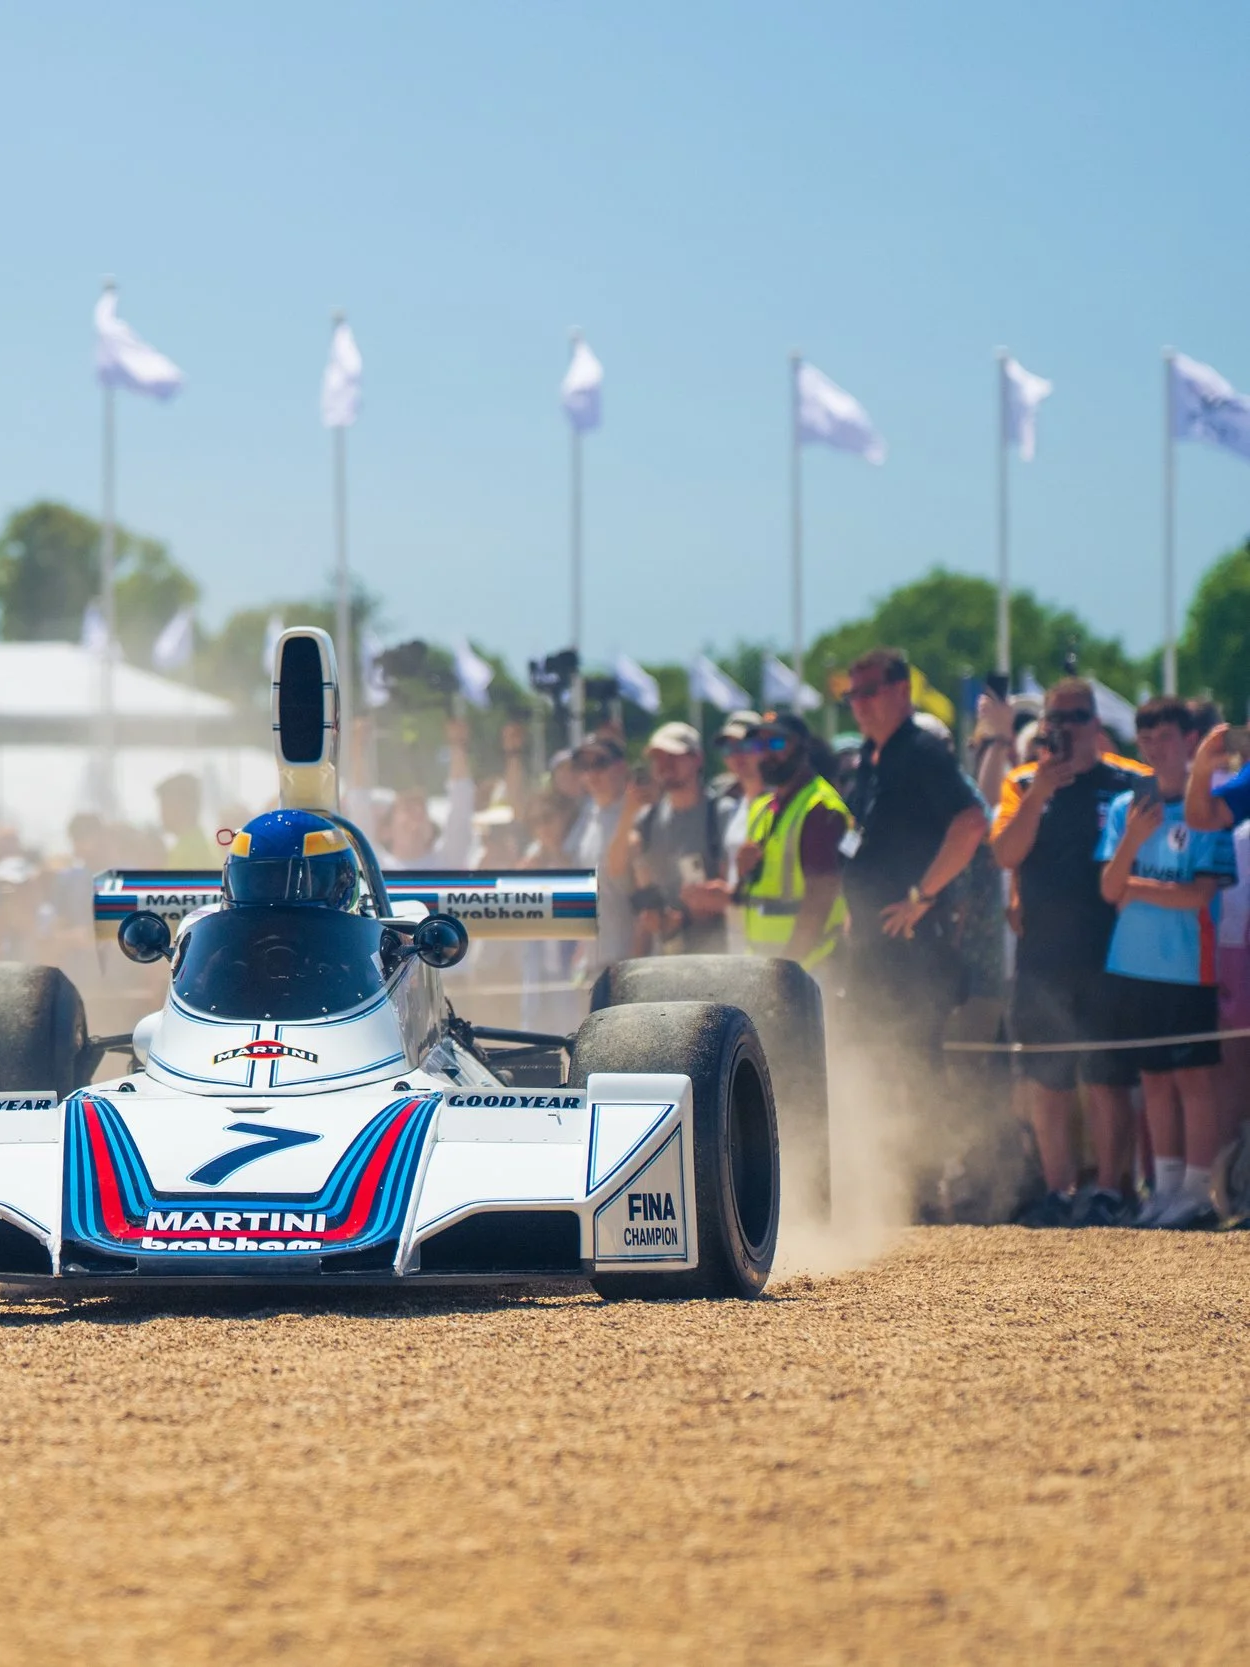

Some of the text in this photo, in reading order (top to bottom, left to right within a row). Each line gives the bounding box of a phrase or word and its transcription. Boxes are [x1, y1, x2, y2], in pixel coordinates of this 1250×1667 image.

[145, 894, 223, 906] MARTI
[446, 892, 544, 905] MARTINI
[447, 907, 544, 919] brabham
[216, 1045, 315, 1063] MARTINI
[448, 1094, 581, 1109] GOODYEAR
[187, 1121, 323, 1187] 7
[627, 1192, 677, 1222] FINA
[145, 1211, 327, 1233] MARTINI
[140, 1236, 323, 1251] brabham
[623, 1226, 679, 1247] CHAMPION
